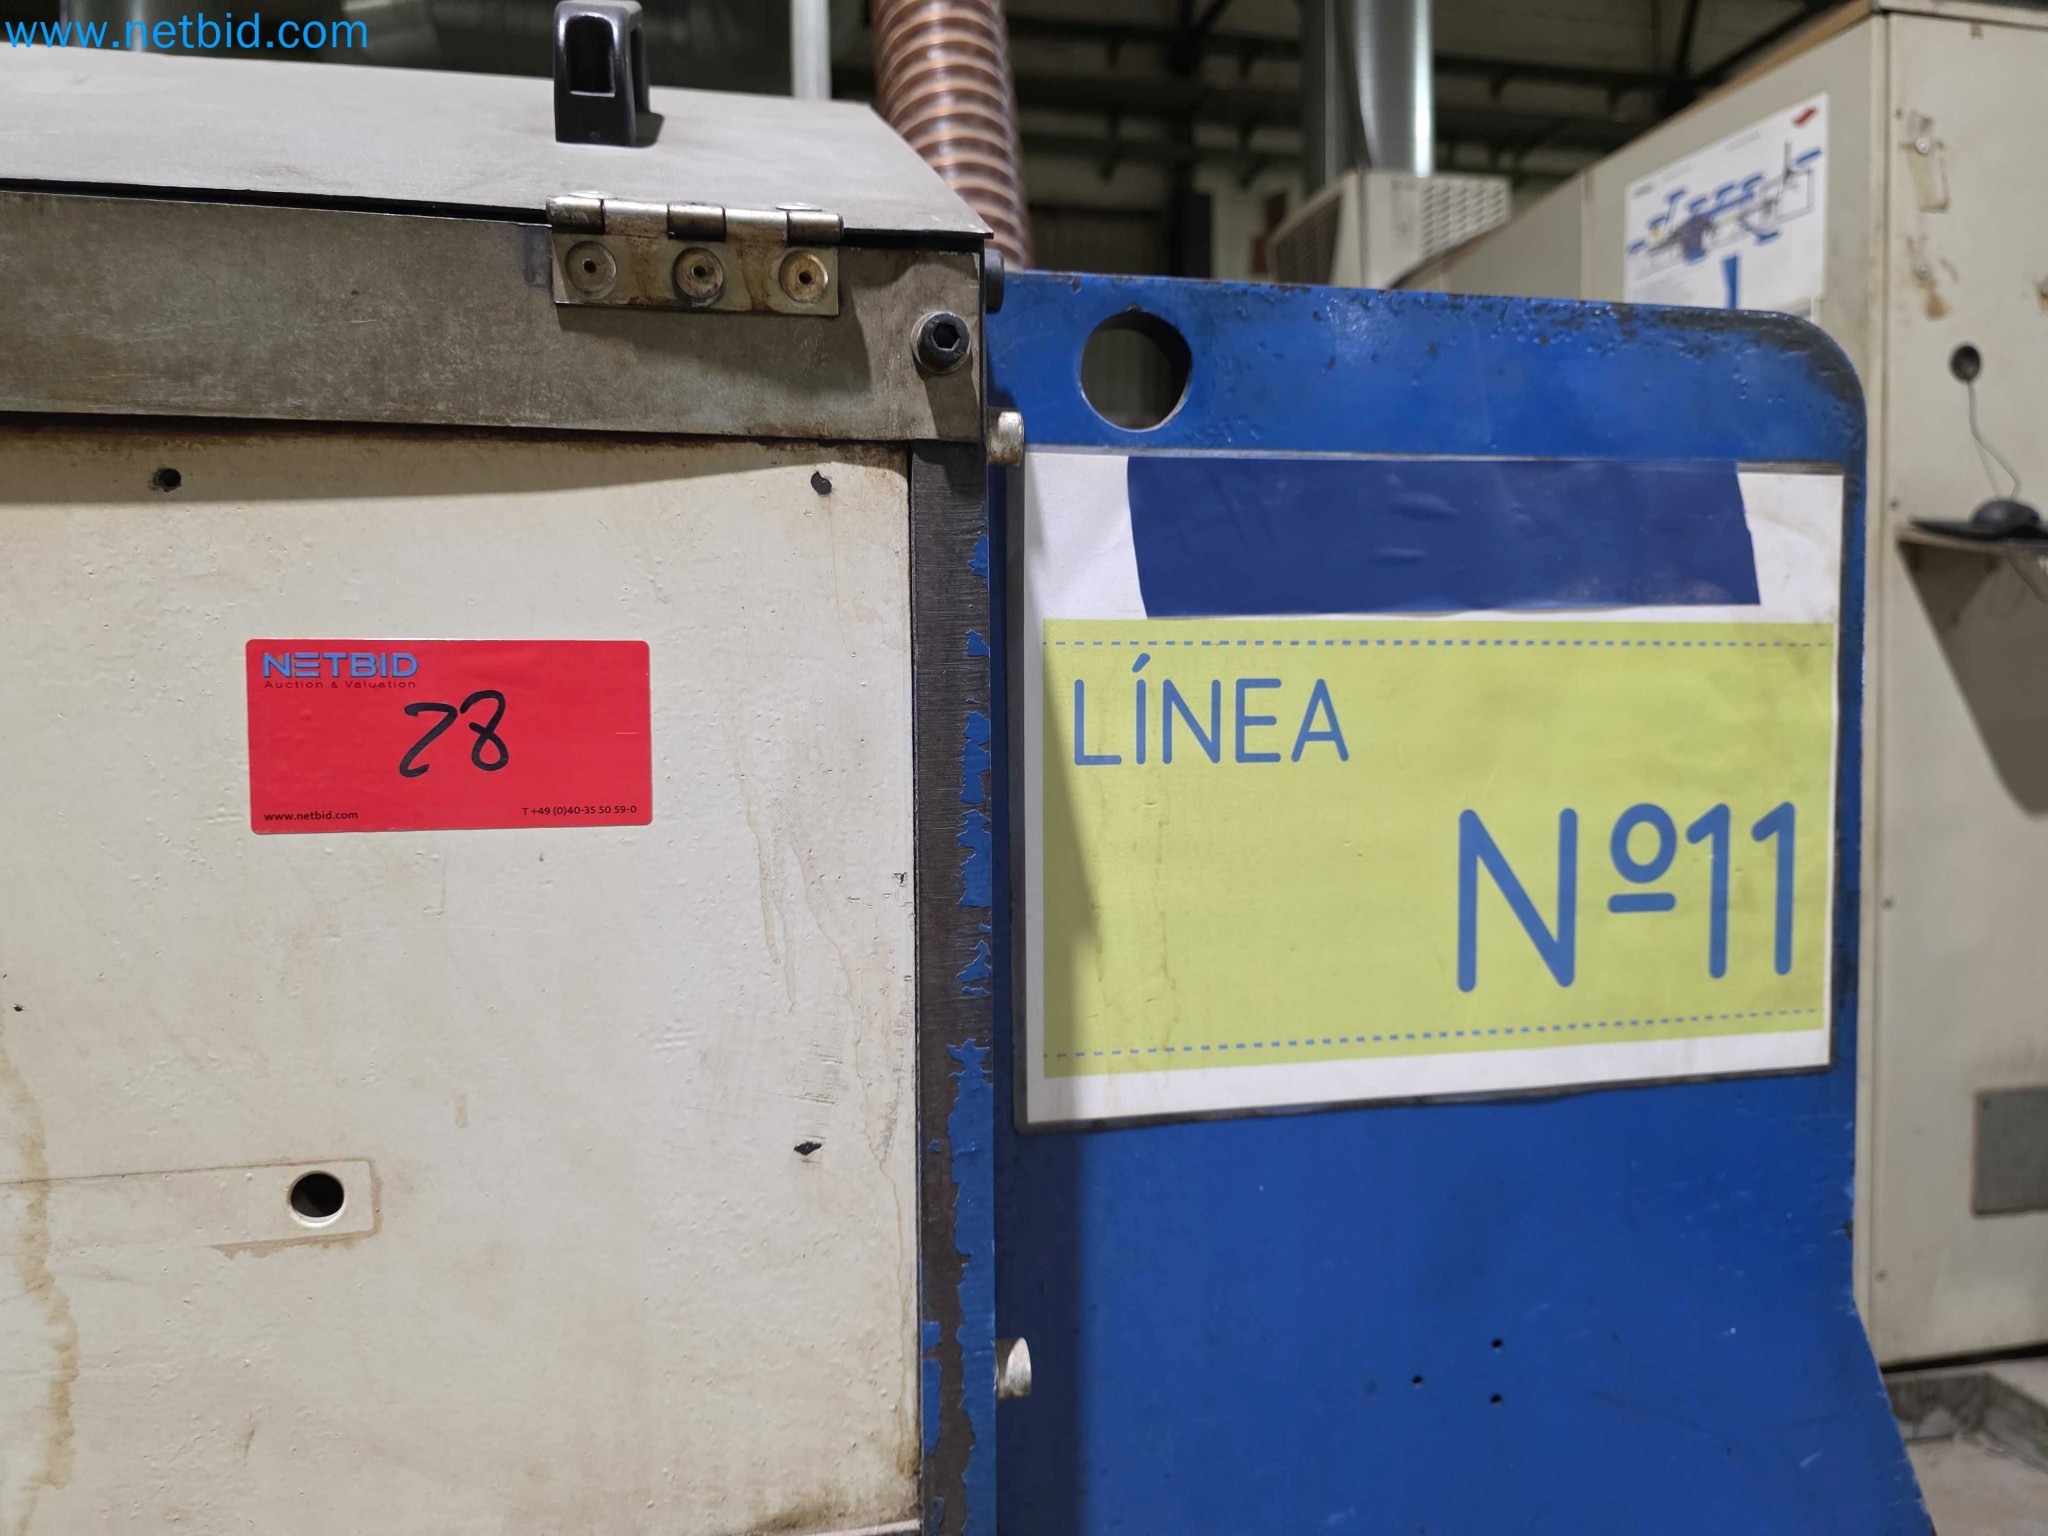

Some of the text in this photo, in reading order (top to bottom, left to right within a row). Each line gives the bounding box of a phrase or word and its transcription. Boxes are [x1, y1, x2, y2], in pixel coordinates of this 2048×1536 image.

[263, 652, 419, 678] NETBID
[263, 680, 416, 689] Auction & Valuation
[1073, 652, 1350, 766] LÍNEA
[399, 689, 509, 778] 28
[264, 810, 359, 821] www.netbid.com
[522, 805, 638, 816] T +49 (0)40-35 50 59-0
